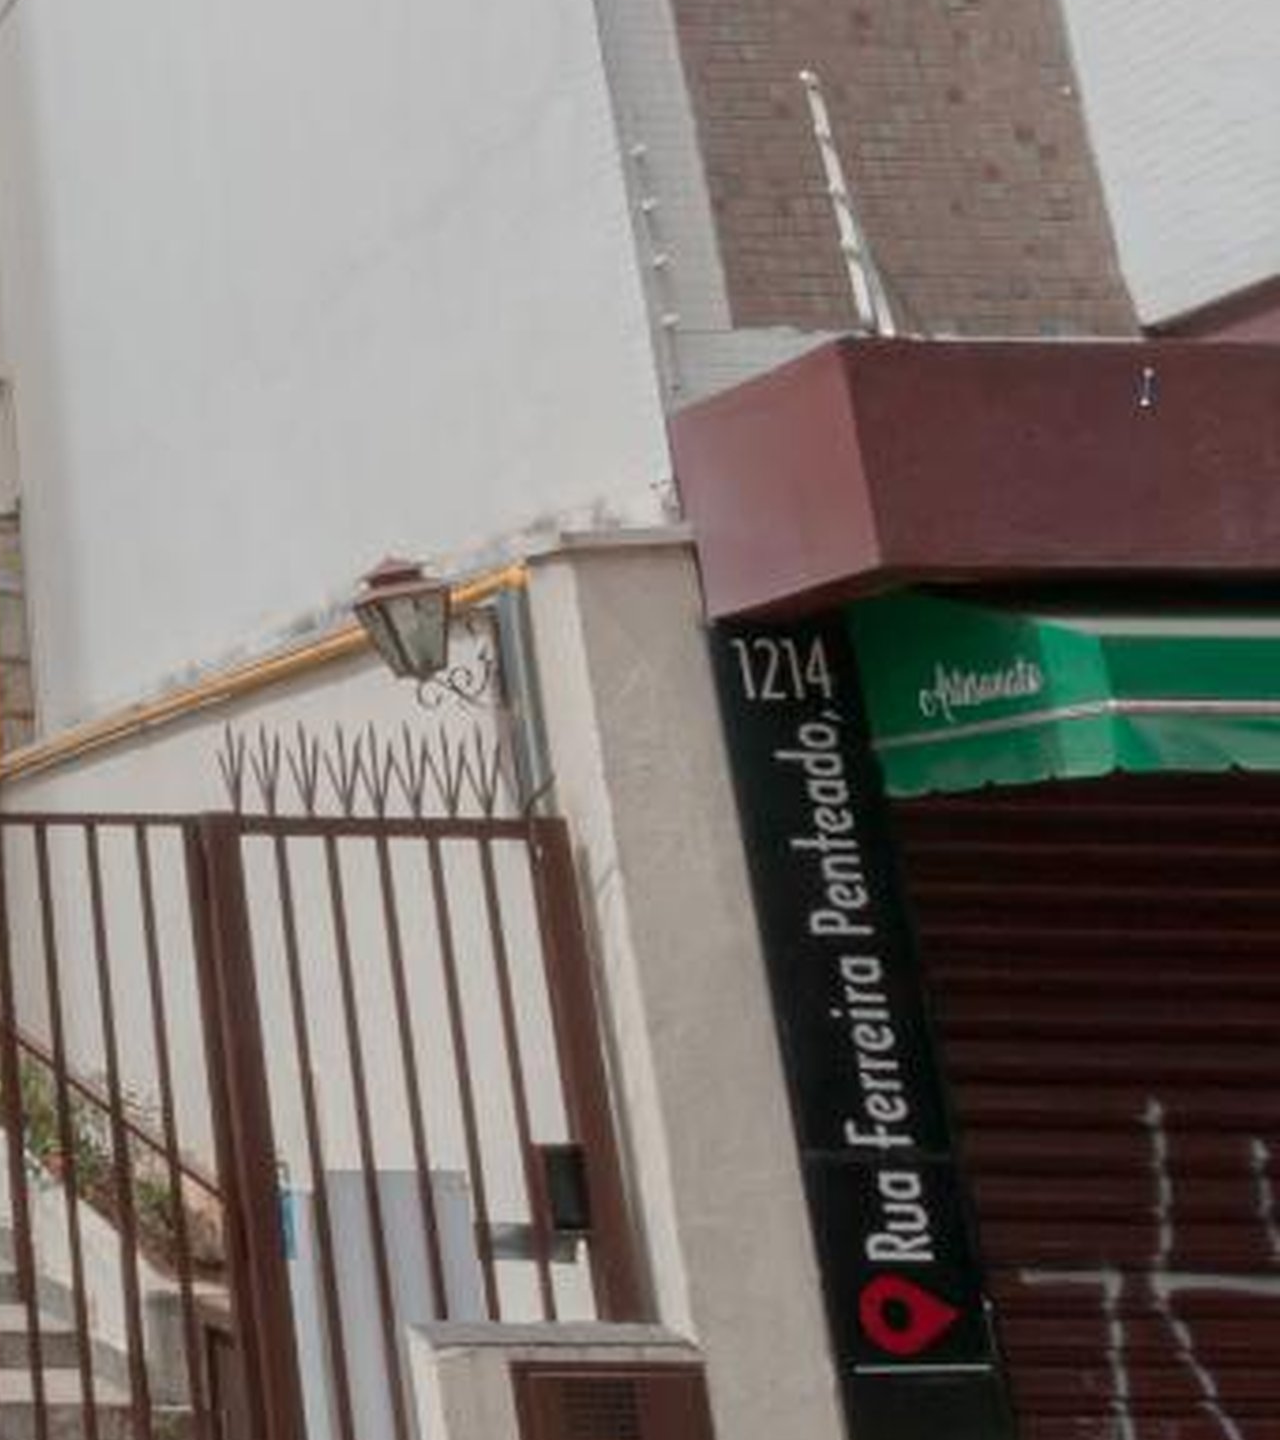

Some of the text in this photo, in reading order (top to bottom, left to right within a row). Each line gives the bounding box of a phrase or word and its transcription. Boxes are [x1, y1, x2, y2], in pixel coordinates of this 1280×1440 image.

[730, 636, 832, 700] 1214
[772, 710, 934, 1261] Rua Ferreira Penteado,
